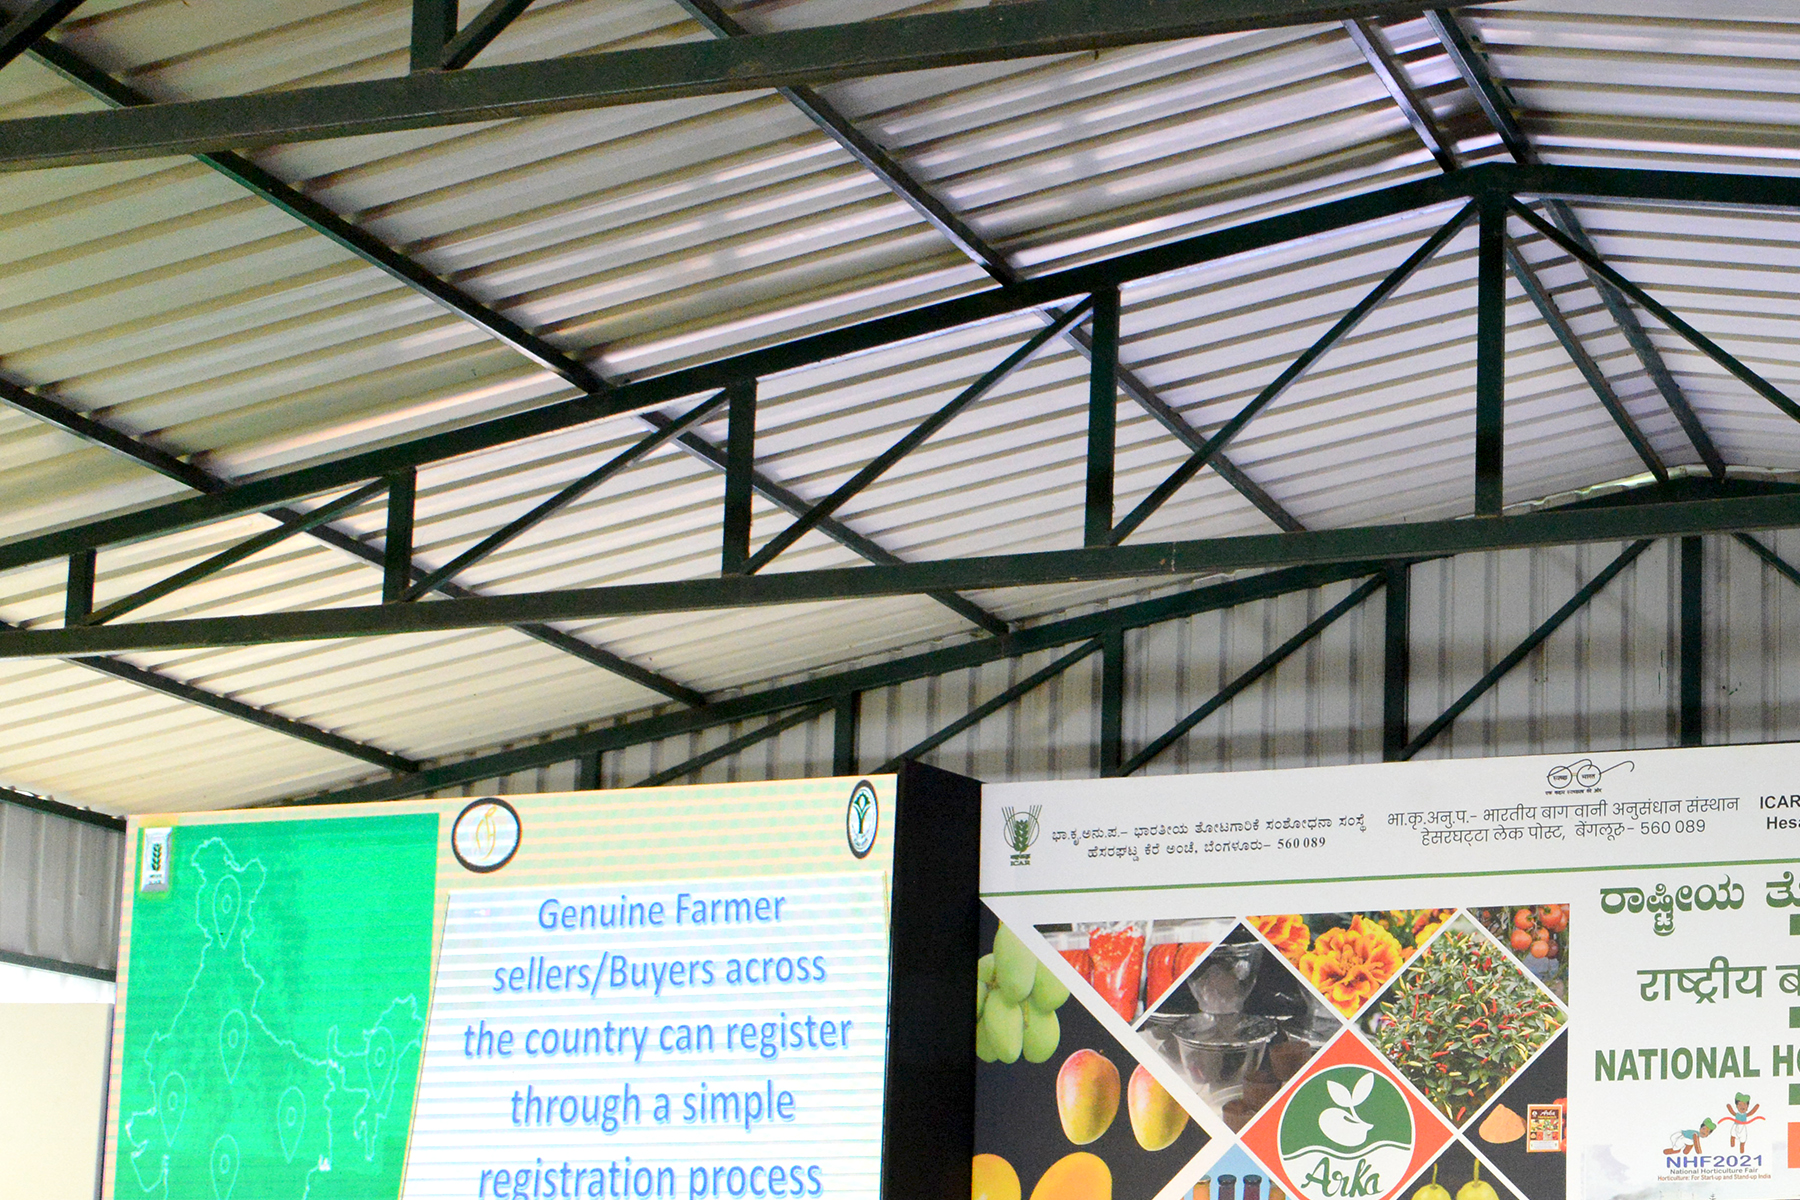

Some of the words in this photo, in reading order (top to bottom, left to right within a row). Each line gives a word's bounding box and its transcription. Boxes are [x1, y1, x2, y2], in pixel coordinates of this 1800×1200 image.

[1483, 803, 1538, 822] भारतीय
[1613, 798, 1682, 820] अनुसंधान
[1686, 796, 1740, 814] संस्थान
[1134, 823, 1189, 839] ಭಾರತೀಯ
[1195, 818, 1260, 834] ತೋಟಗಾರಿಕೆ
[1144, 843, 1160, 856] ಕೆರೆ
[1277, 837, 1300, 850] 560
[1303, 836, 1326, 849] 089
[1493, 824, 1525, 841] लेक
[1528, 822, 1566, 841] पोस्ट,
[1640, 820, 1671, 835] 560
[1675, 818, 1706, 834] 089
[538, 894, 666, 930] Genuine
[675, 893, 786, 925] Farmer
[493, 951, 715, 998] sellers/Buyers
[726, 954, 828, 985] across
[1637, 955, 1767, 1004] राष्ट्रीय
[463, 1020, 515, 1058] the
[525, 1021, 648, 1063] country
[658, 1022, 715, 1053] can
[726, 1012, 853, 1060] register
[1594, 1043, 1761, 1083] NATIONAL
[511, 1083, 641, 1133] through
[653, 1093, 671, 1123] a
[683, 1079, 796, 1132] simple
[1666, 1155, 1762, 1168] NHF2021
